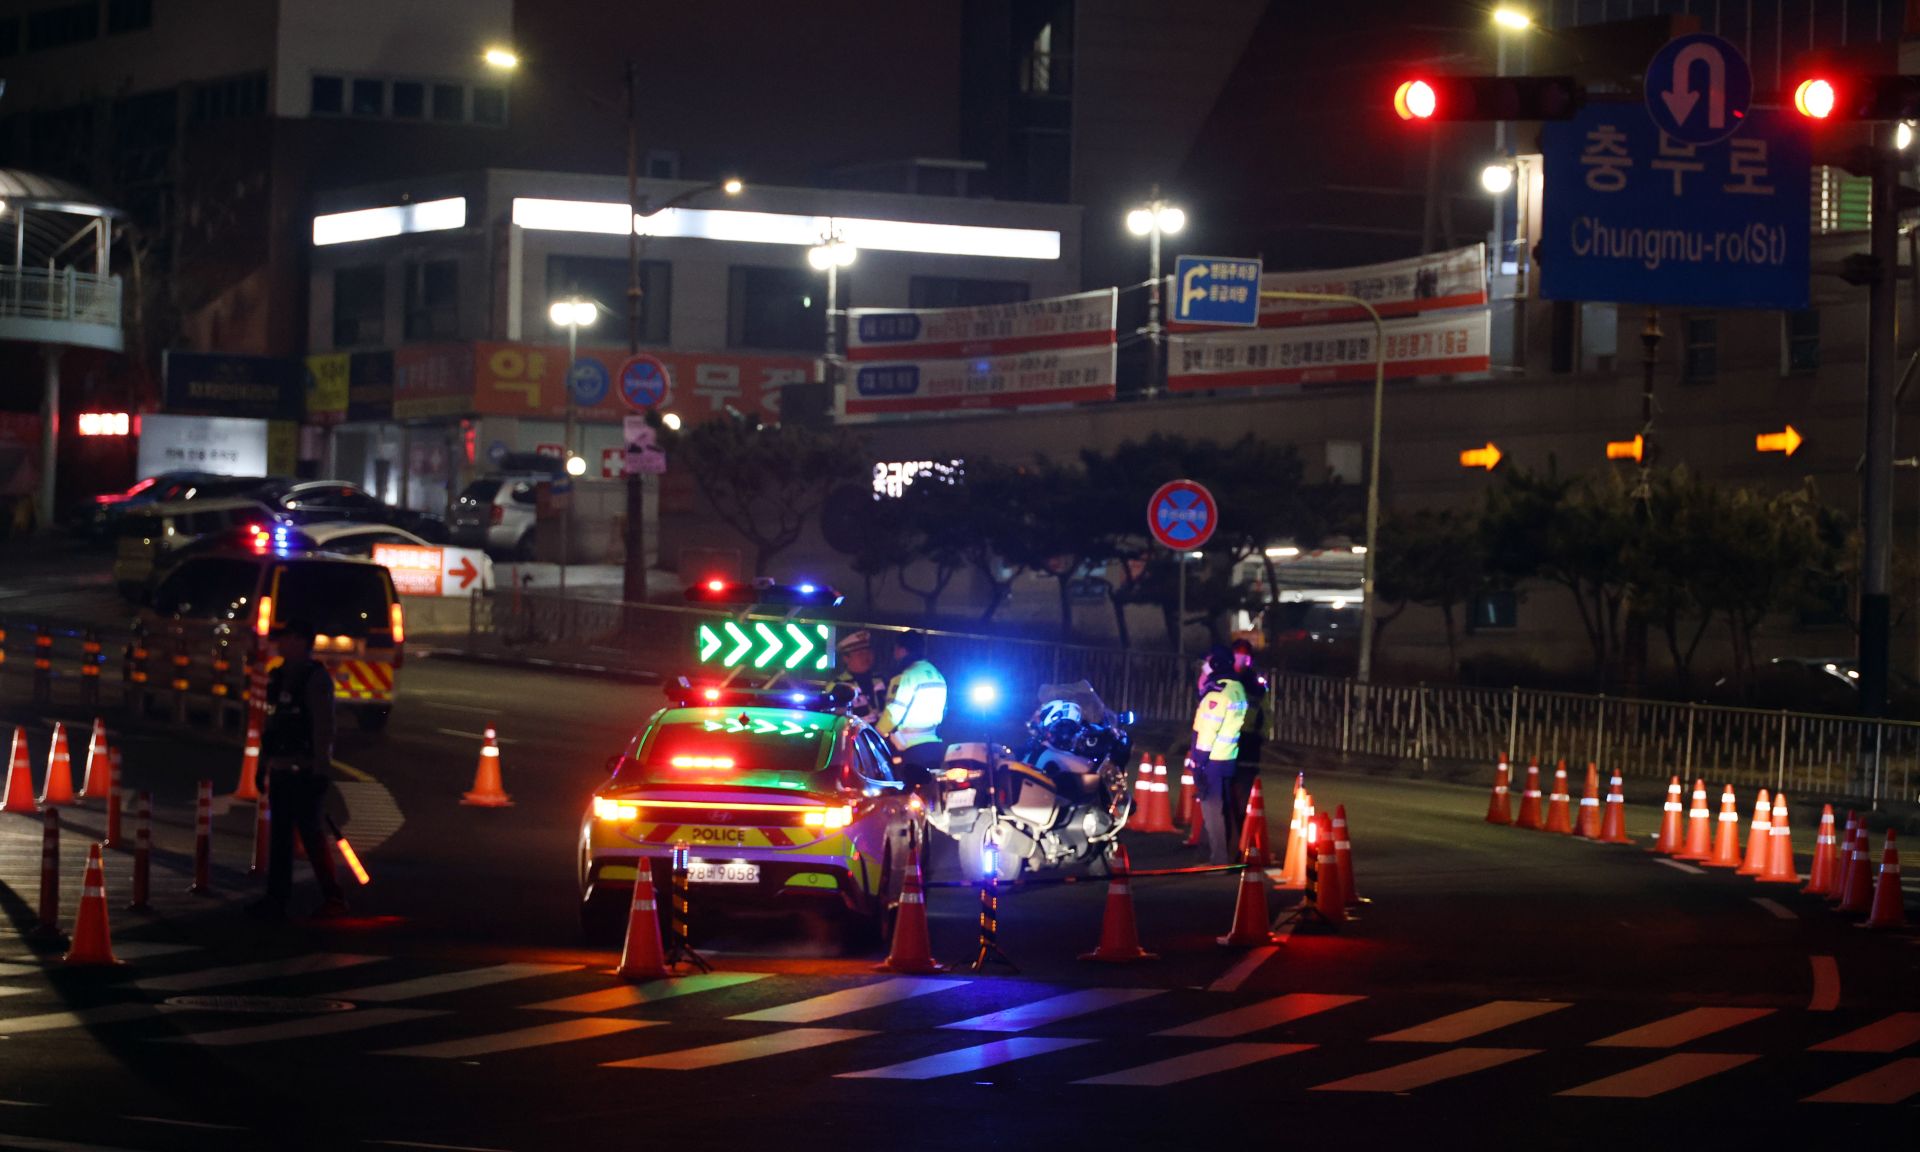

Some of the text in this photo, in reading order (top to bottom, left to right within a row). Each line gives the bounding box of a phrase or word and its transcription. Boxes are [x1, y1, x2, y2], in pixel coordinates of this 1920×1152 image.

[1580, 124, 1776, 197] 충무로
[1571, 215, 1787, 270] Chungmu-ro(St)
[489, 349, 545, 408] 약
[693, 829, 745, 842] POLICE
